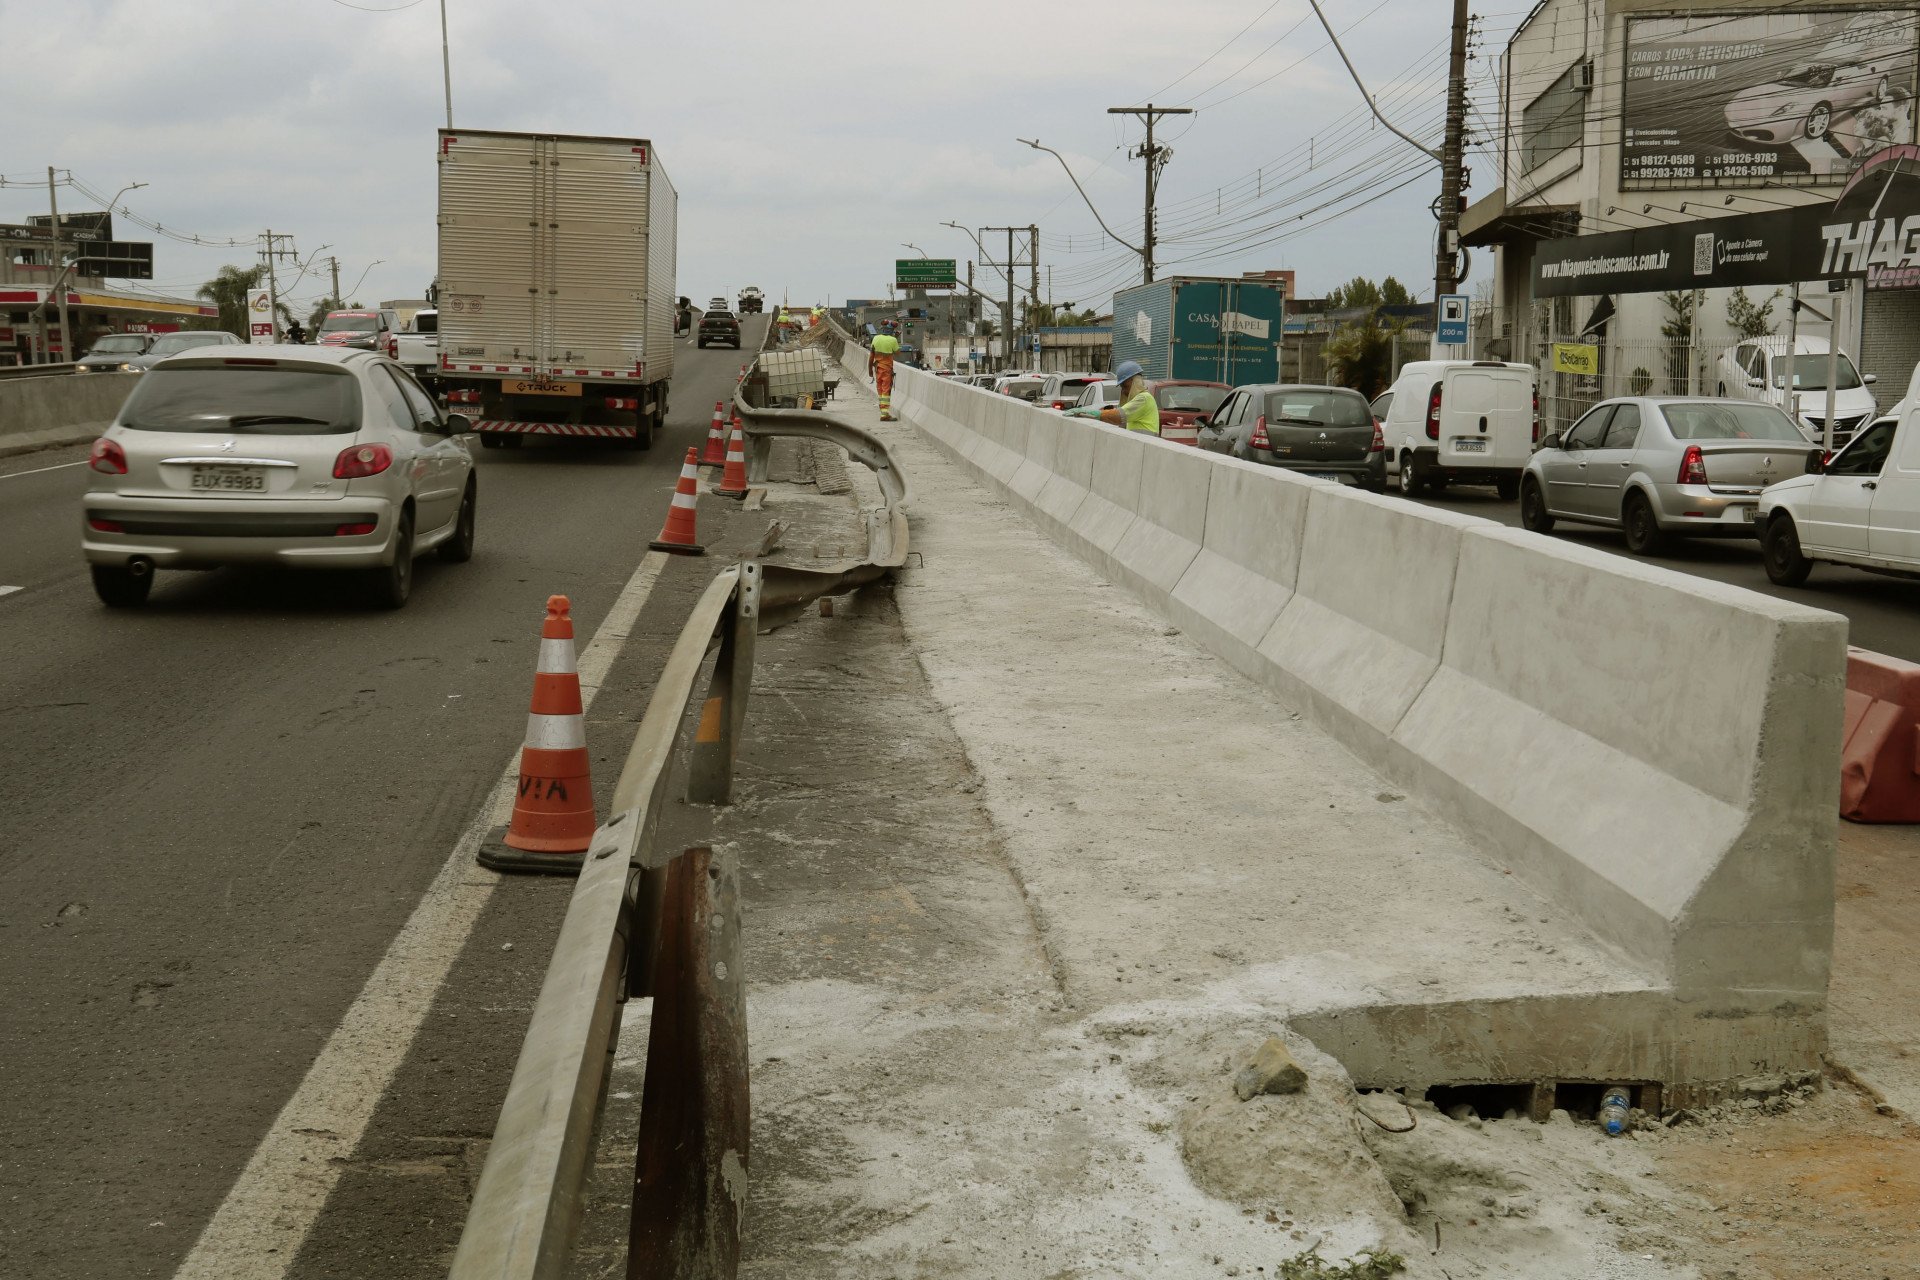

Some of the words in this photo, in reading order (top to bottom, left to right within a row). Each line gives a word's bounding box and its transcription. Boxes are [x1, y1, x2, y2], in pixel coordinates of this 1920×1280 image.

[1632, 51, 1661, 62] CARROS
[1665, 48, 1694, 60] 100%
[1698, 44, 1765, 60] REVISADOS
[1628, 67, 1633, 77] E
[1634, 66, 1651, 77] COM
[1654, 65, 1717, 81] GARANTIA
[1641, 154, 1695, 166] 98127-0589
[1713, 156, 1721, 164] 51
[1722, 152, 1777, 164] 99126-9783
[1631, 170, 1639, 178] 51
[1640, 167, 1695, 178] 99203-7429
[1715, 169, 1723, 177] 51
[1724, 165, 1774, 177] 3426-5160
[1541, 249, 1670, 278] www.thiagoveiculoscanoas.com.br
[1188, 312, 1217, 322] CASA
[1232, 320, 1263, 330] PAPEL
[1442, 328, 1456, 336] 200
[527, 383, 568, 393] TRUCK
